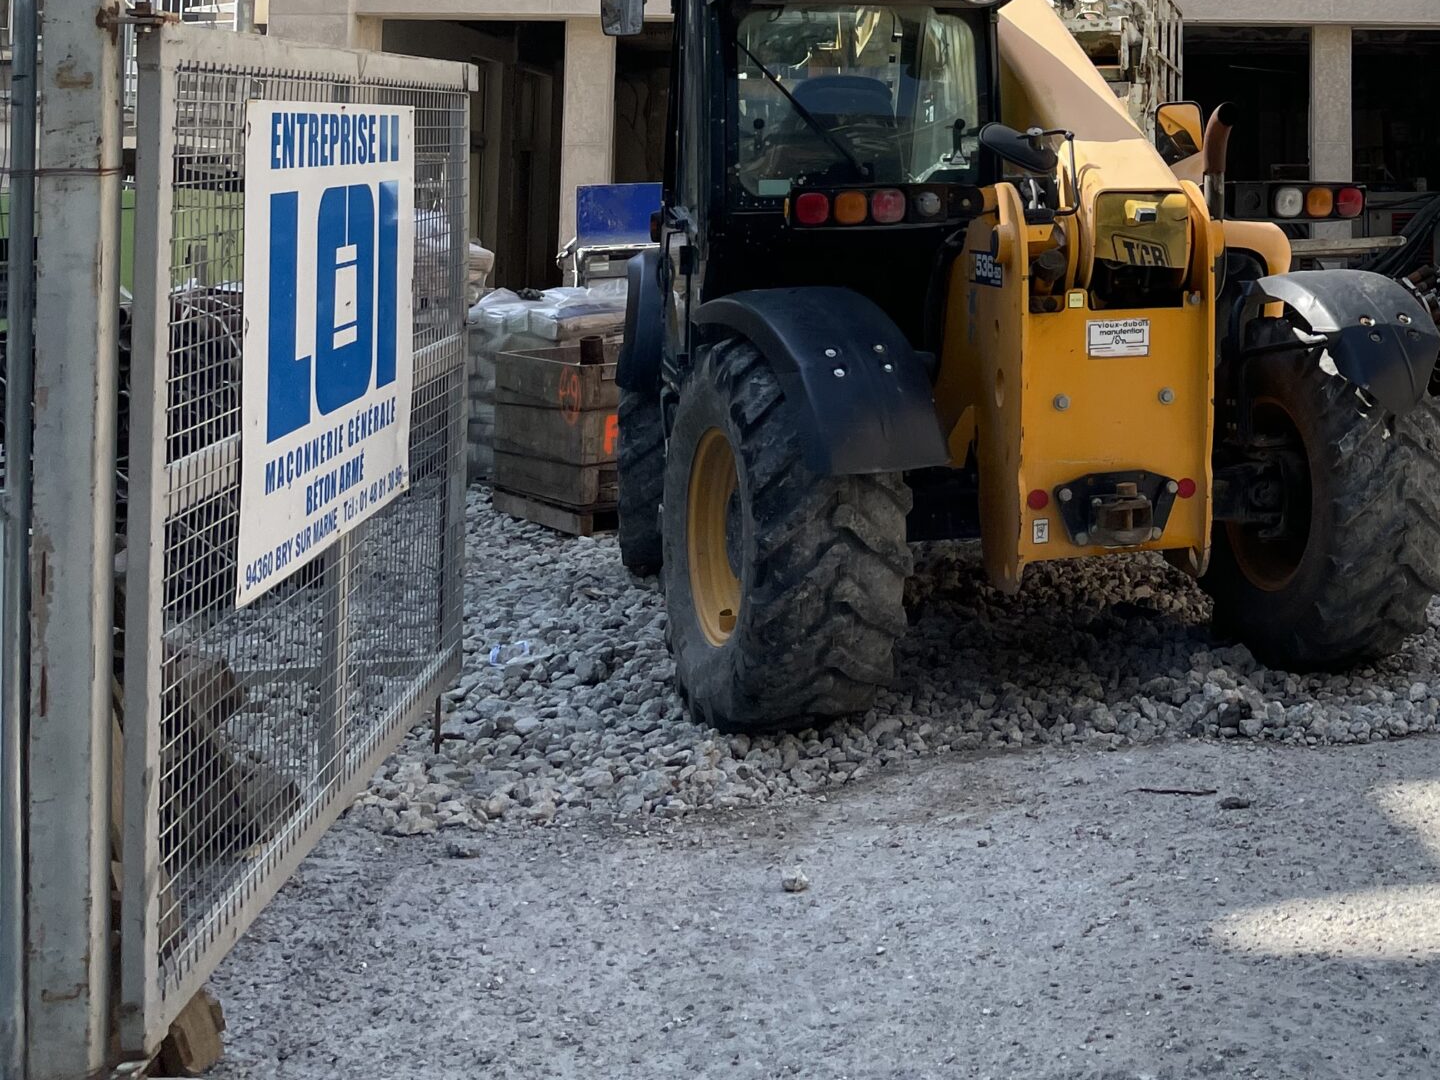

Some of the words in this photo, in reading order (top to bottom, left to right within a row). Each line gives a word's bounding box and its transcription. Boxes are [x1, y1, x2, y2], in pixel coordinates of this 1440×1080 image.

[270, 112, 376, 170] ENTREPRISE
[266, 179, 399, 445] LOI
[1099, 327, 1144, 336] manutention
[265, 423, 344, 496] MAÇONNERIE
[348, 396, 396, 448] GÉNÉRALE
[306, 469, 337, 516] BÉTON
[339, 447, 365, 495] ARMÉ
[245, 551, 273, 591] 94360
[275, 536, 294, 572] BRY
[295, 526, 312, 558] SUR
[313, 506, 338, 545] MARNE
[360, 487, 368, 512] 01
